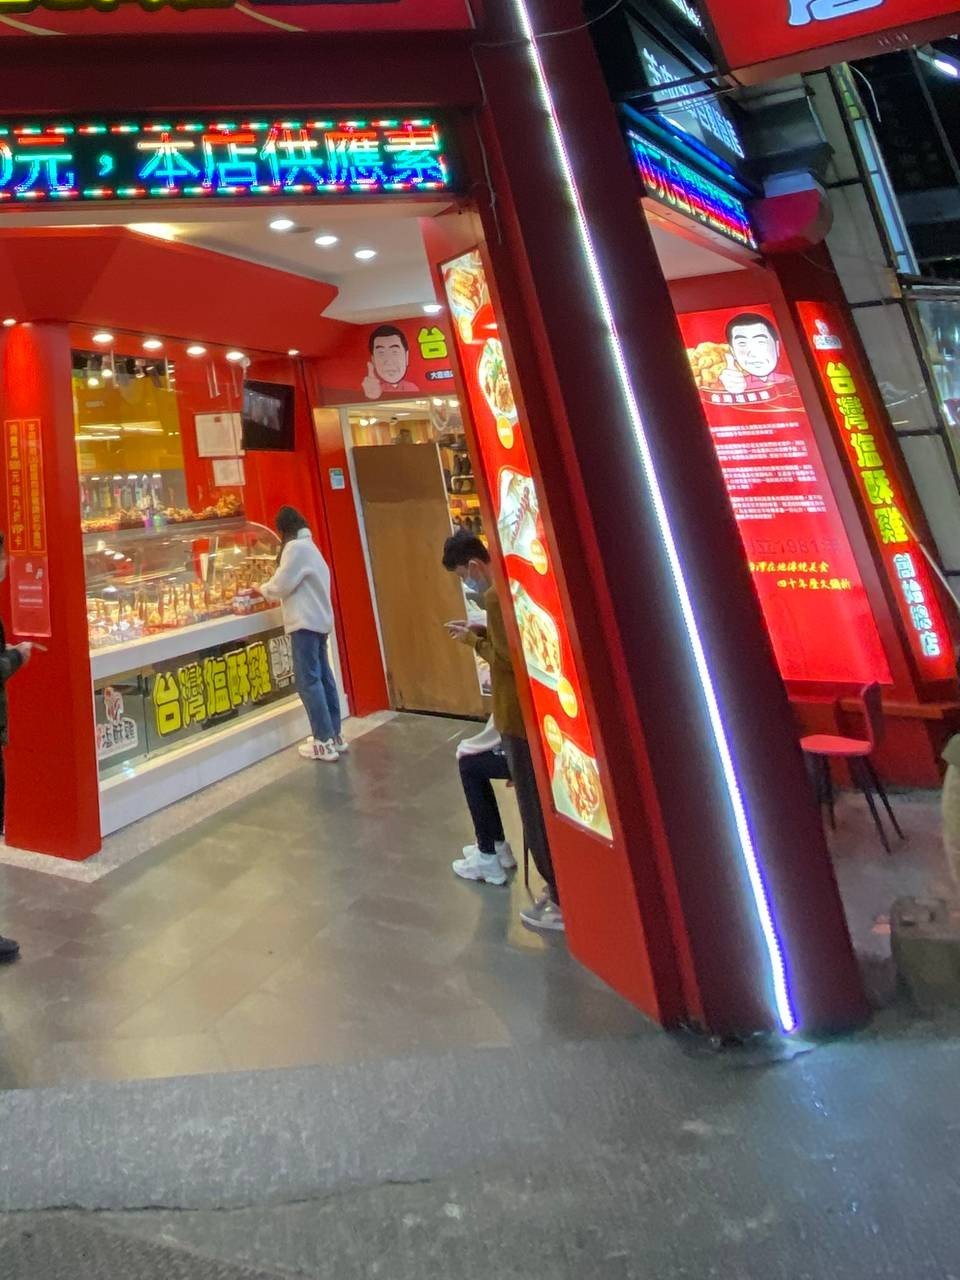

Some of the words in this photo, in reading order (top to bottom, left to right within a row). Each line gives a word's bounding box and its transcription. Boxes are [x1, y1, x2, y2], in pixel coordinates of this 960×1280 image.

[826, 361, 908, 543] 台灣塩酥雞
[153, 641, 272, 736] 台灣塩酥雞
